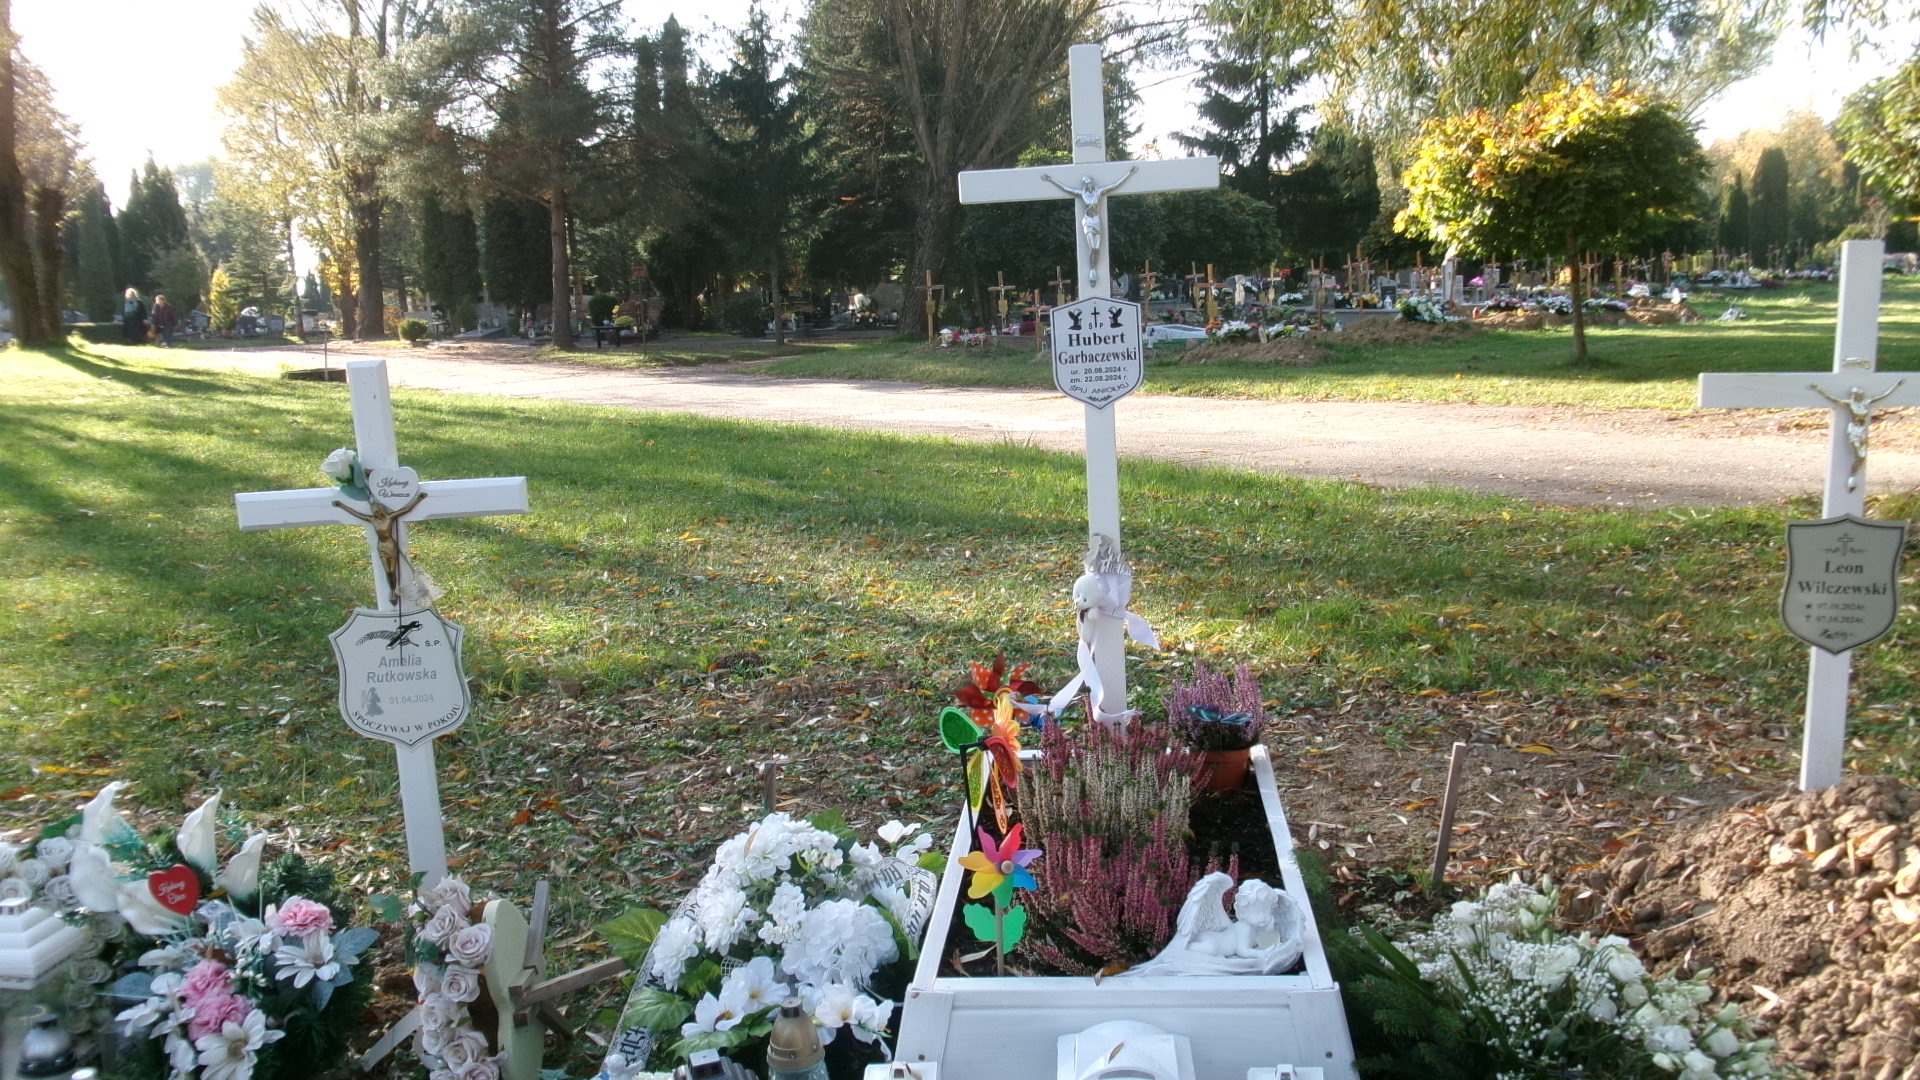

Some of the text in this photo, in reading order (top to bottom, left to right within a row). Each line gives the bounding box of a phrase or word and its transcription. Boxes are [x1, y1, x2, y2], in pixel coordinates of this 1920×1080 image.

[1067, 332, 1126, 347] Hubert
[1058, 347, 1137, 365] Garbaczewski
[1083, 366, 1122, 375] 20.08.2024
[1084, 374, 1122, 383] 22.08.2024
[1824, 561, 1864, 574] Leon
[1798, 581, 1887, 595] Wilczewski
[378, 653, 422, 669] Amelia
[366, 668, 438, 684] Rutkowska
[352, 703, 461, 734] SPOCZYWAJ W POKOJU
